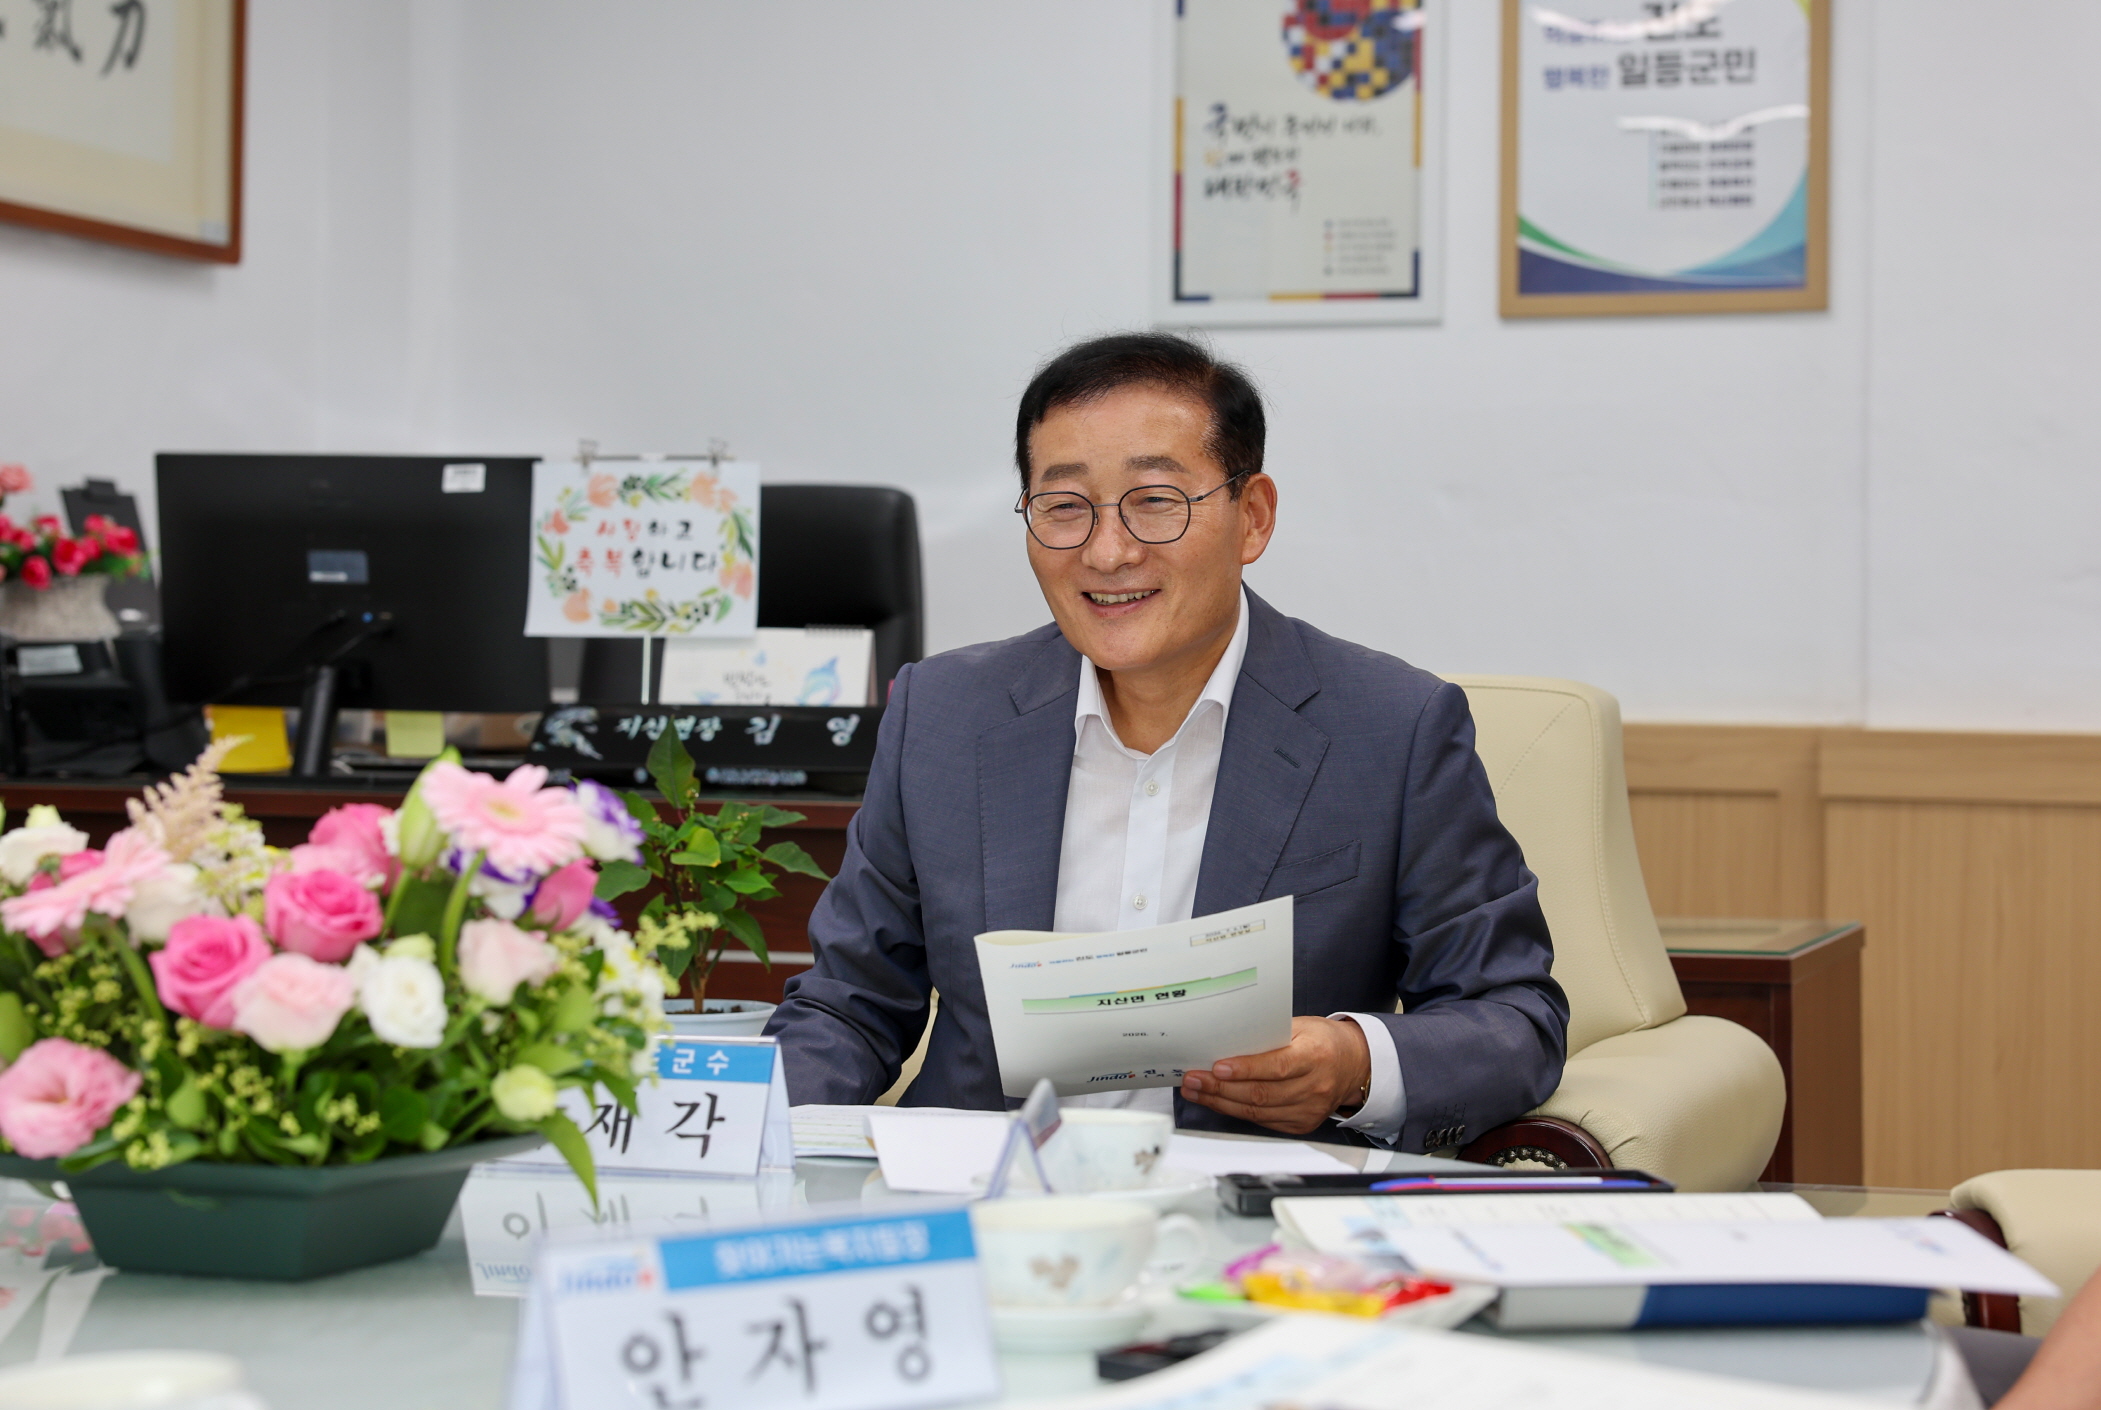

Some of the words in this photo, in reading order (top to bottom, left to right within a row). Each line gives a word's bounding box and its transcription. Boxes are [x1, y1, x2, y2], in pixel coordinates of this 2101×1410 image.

[1617, 49, 1756, 87] 일등군민
[597, 519, 693, 542] 사랑하고
[576, 548, 717, 577] 축복합니다
[826, 713, 860, 747] 영
[1097, 995, 1145, 1006] 지산면
[1155, 989, 1187, 1001] 현황
[1086, 1072, 1128, 1083] Jindo
[582, 1091, 726, 1160] 재각
[620, 1283, 933, 1410] 안자영
